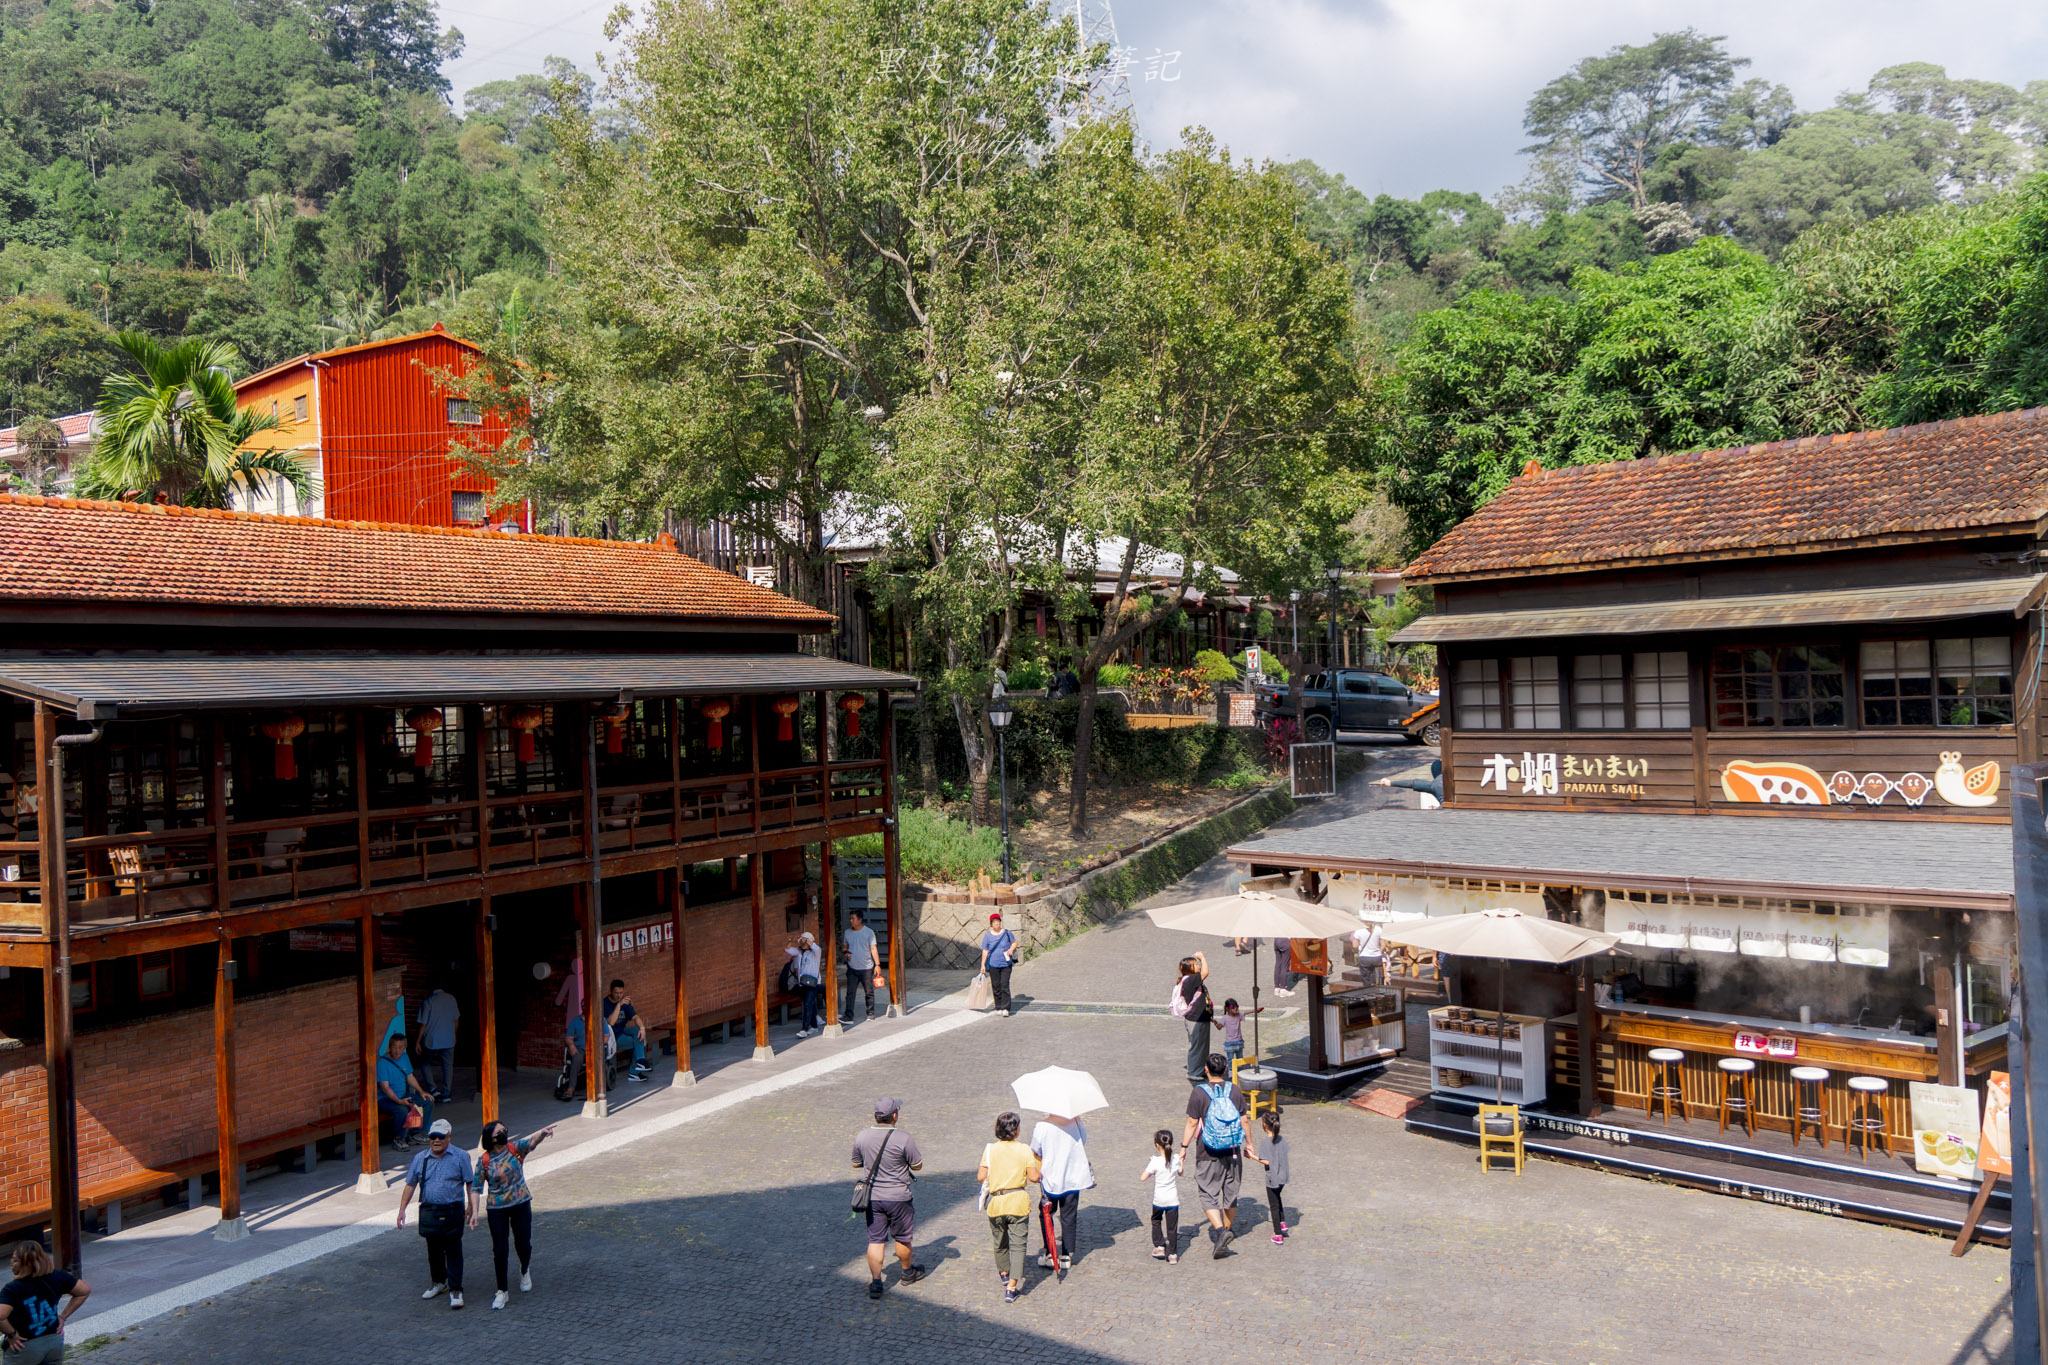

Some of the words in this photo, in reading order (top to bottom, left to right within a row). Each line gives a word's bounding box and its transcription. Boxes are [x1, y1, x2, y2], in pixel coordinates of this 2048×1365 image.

[1480, 752, 1559, 795] 木蝸
[1563, 754, 1648, 778] まいまい
[1564, 783, 1606, 793] PAPAYA
[1611, 784, 1646, 795] SNAIL
[1740, 1035, 1751, 1047] 我
